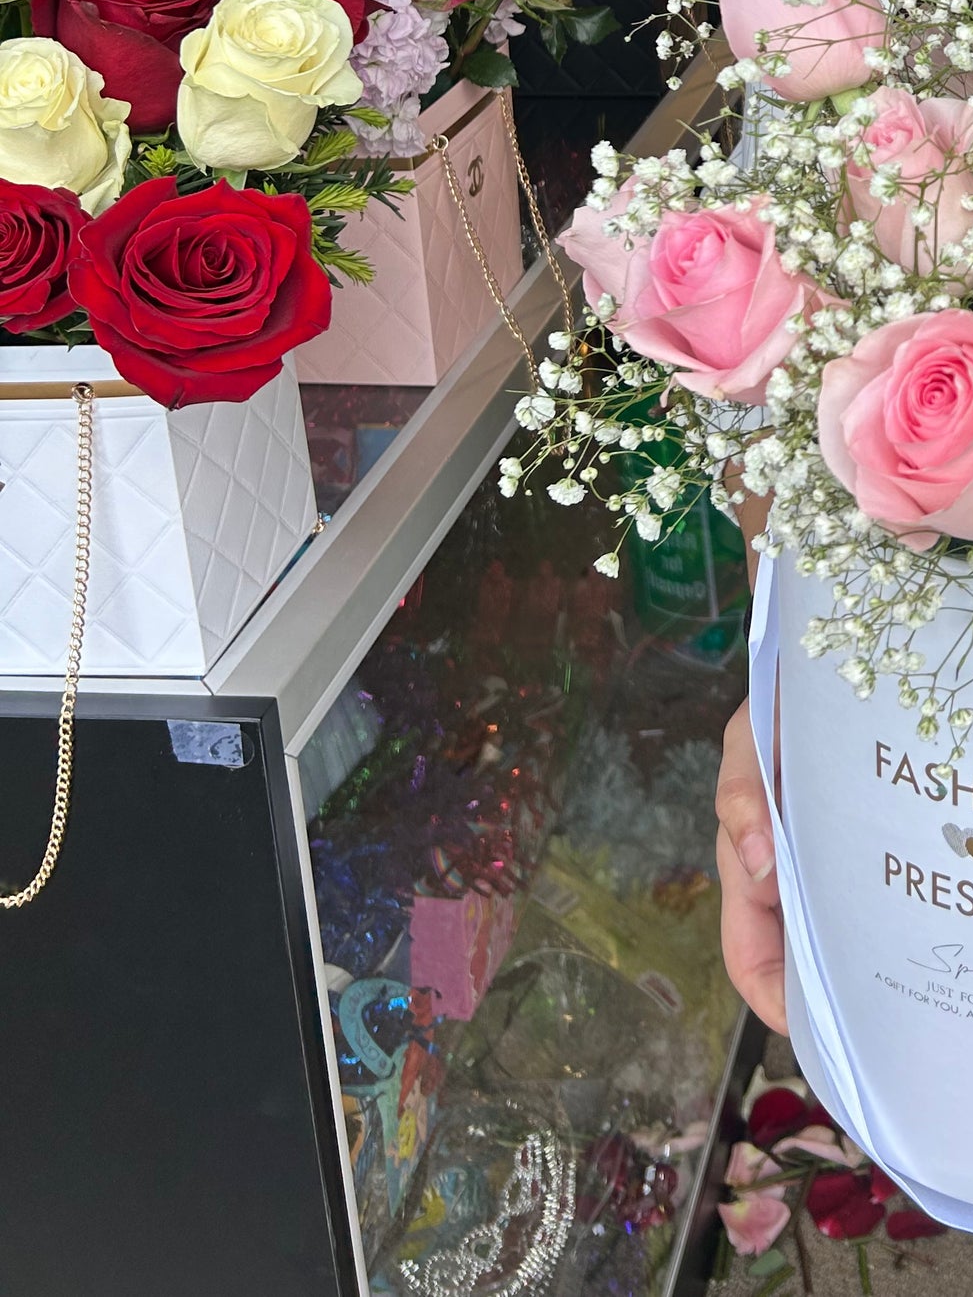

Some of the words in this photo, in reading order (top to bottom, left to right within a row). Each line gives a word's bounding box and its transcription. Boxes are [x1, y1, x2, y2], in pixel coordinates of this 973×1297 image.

[874, 971, 883, 981] A
[885, 976, 906, 994] GIFT
[908, 988, 931, 1004] FOR
[933, 998, 962, 1017] YOU,
[926, 981, 954, 999] JUST
